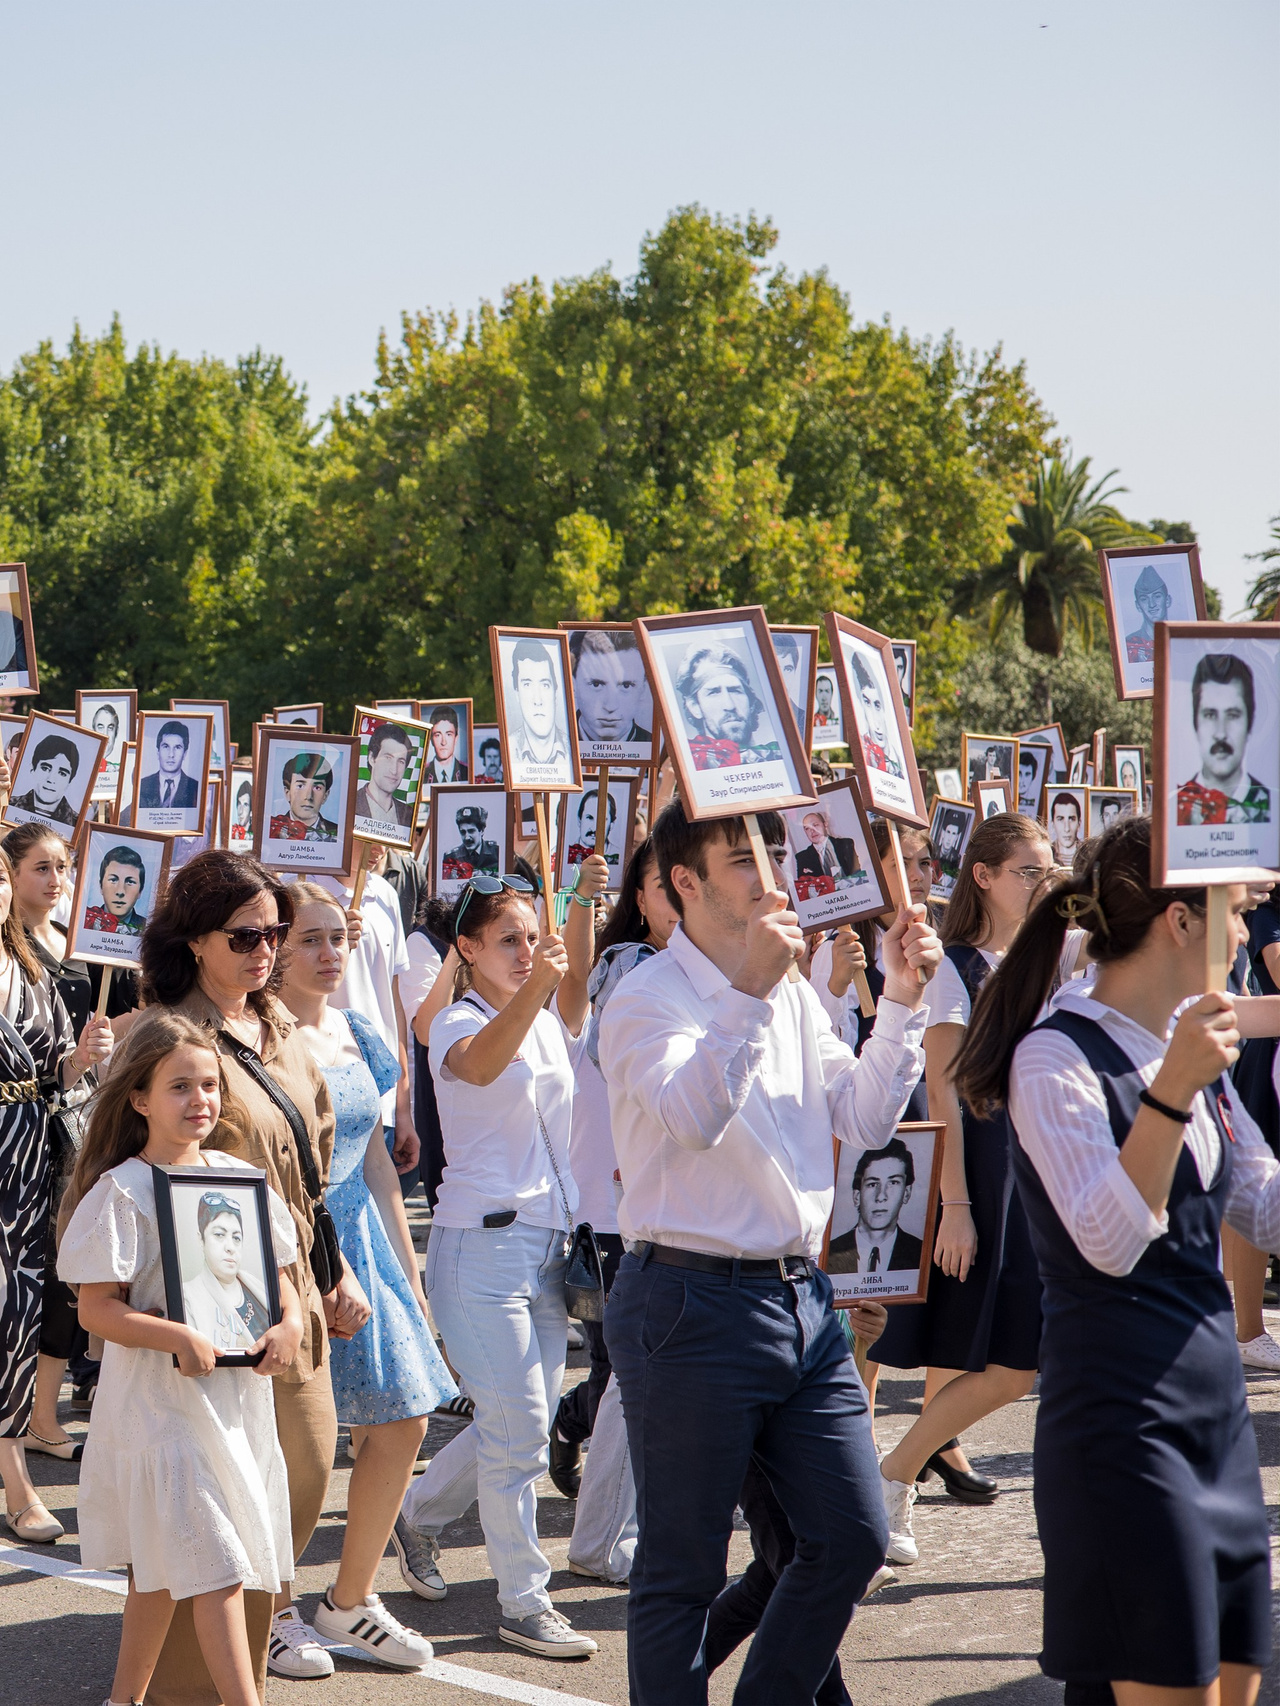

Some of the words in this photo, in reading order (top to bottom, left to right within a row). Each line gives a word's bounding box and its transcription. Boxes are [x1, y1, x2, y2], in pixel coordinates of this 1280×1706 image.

[723, 770, 764, 783] ЧЕХЕРИЯ
[710, 786, 728, 798] Заур
[729, 781, 784, 795] Спиридонович
[363, 819, 396, 832] АДЛЕЙБА
[370, 828, 407, 841] Назимович
[1210, 831, 1234, 841] КАПШ
[289, 845, 315, 853] ШАМБА
[1186, 848, 1208, 859] Юрий
[1211, 848, 1259, 858] Самсонович
[824, 894, 849, 906] ЧАГАВА
[807, 908, 835, 920] Рудольф
[835, 898, 872, 912] Николаевич
[101, 936, 124, 946] ШАМБА
[90, 943, 103, 951] Анри
[103, 945, 133, 955] Эдуардович
[861, 1276, 882, 1285] АИБА
